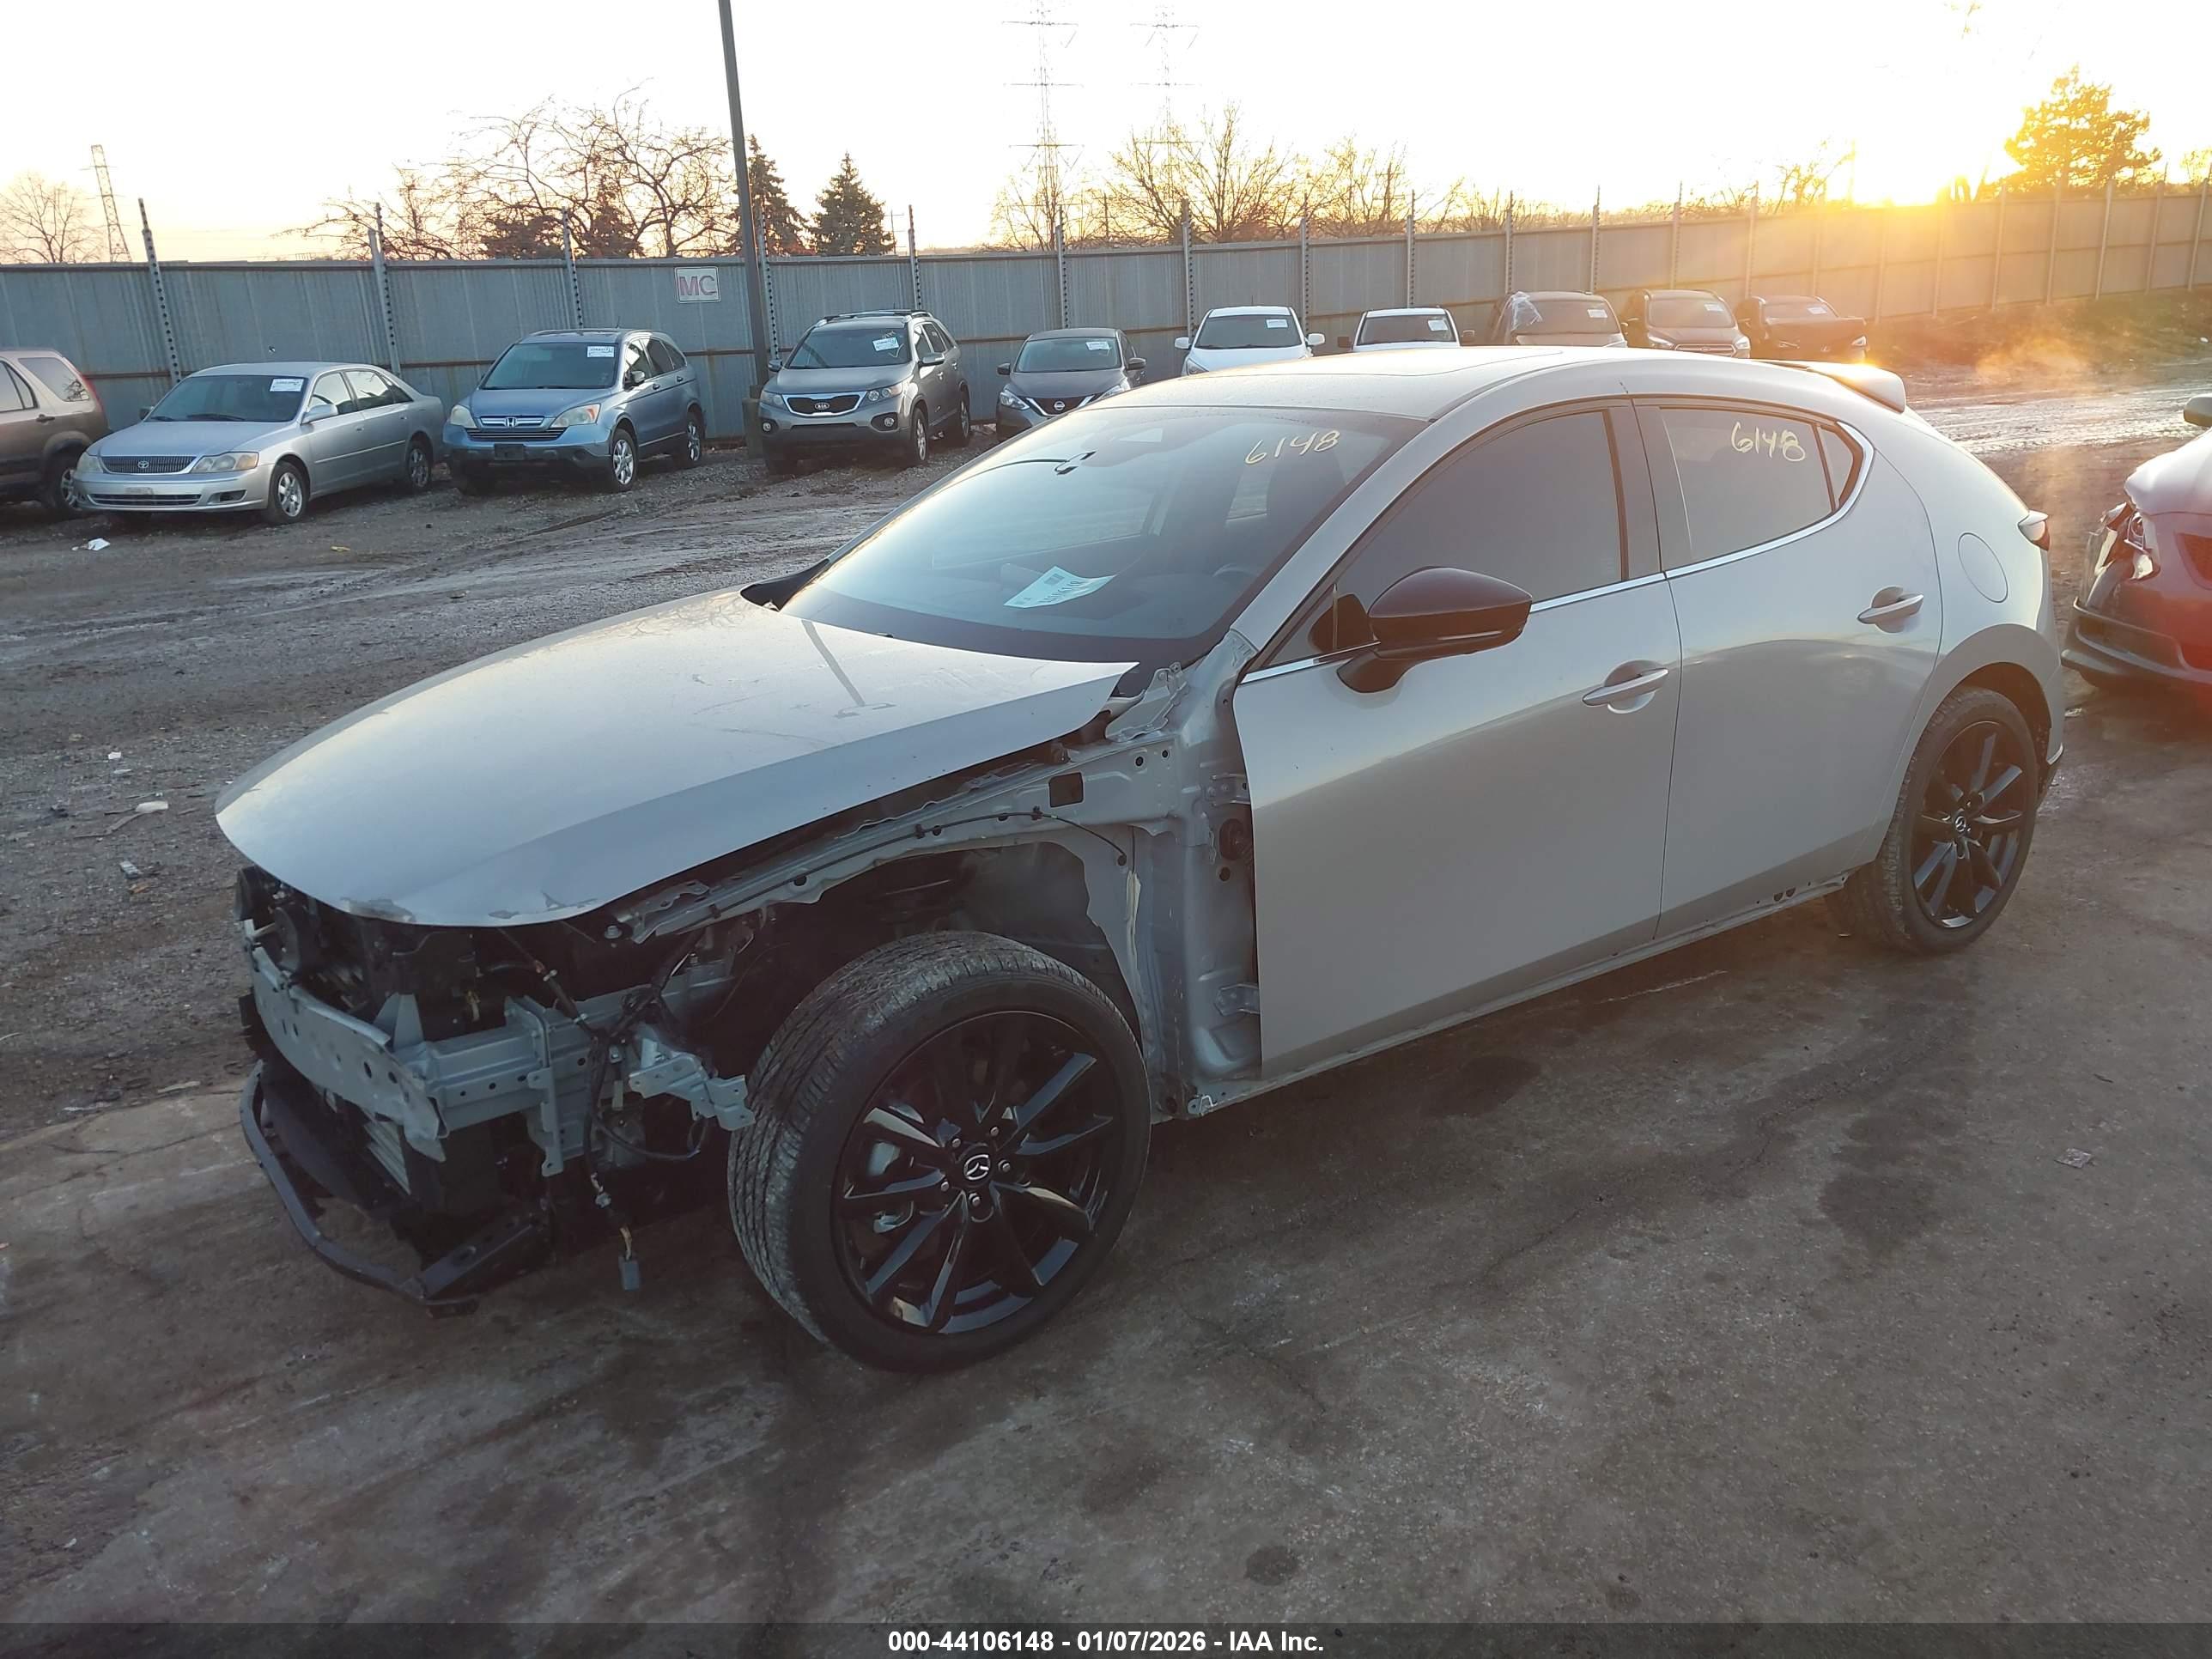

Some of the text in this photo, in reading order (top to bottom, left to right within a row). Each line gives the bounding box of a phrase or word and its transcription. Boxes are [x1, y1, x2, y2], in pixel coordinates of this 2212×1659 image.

[679, 275, 717, 295] MC
[1245, 430, 1340, 464] 6148
[1731, 422, 1805, 461] 6148
